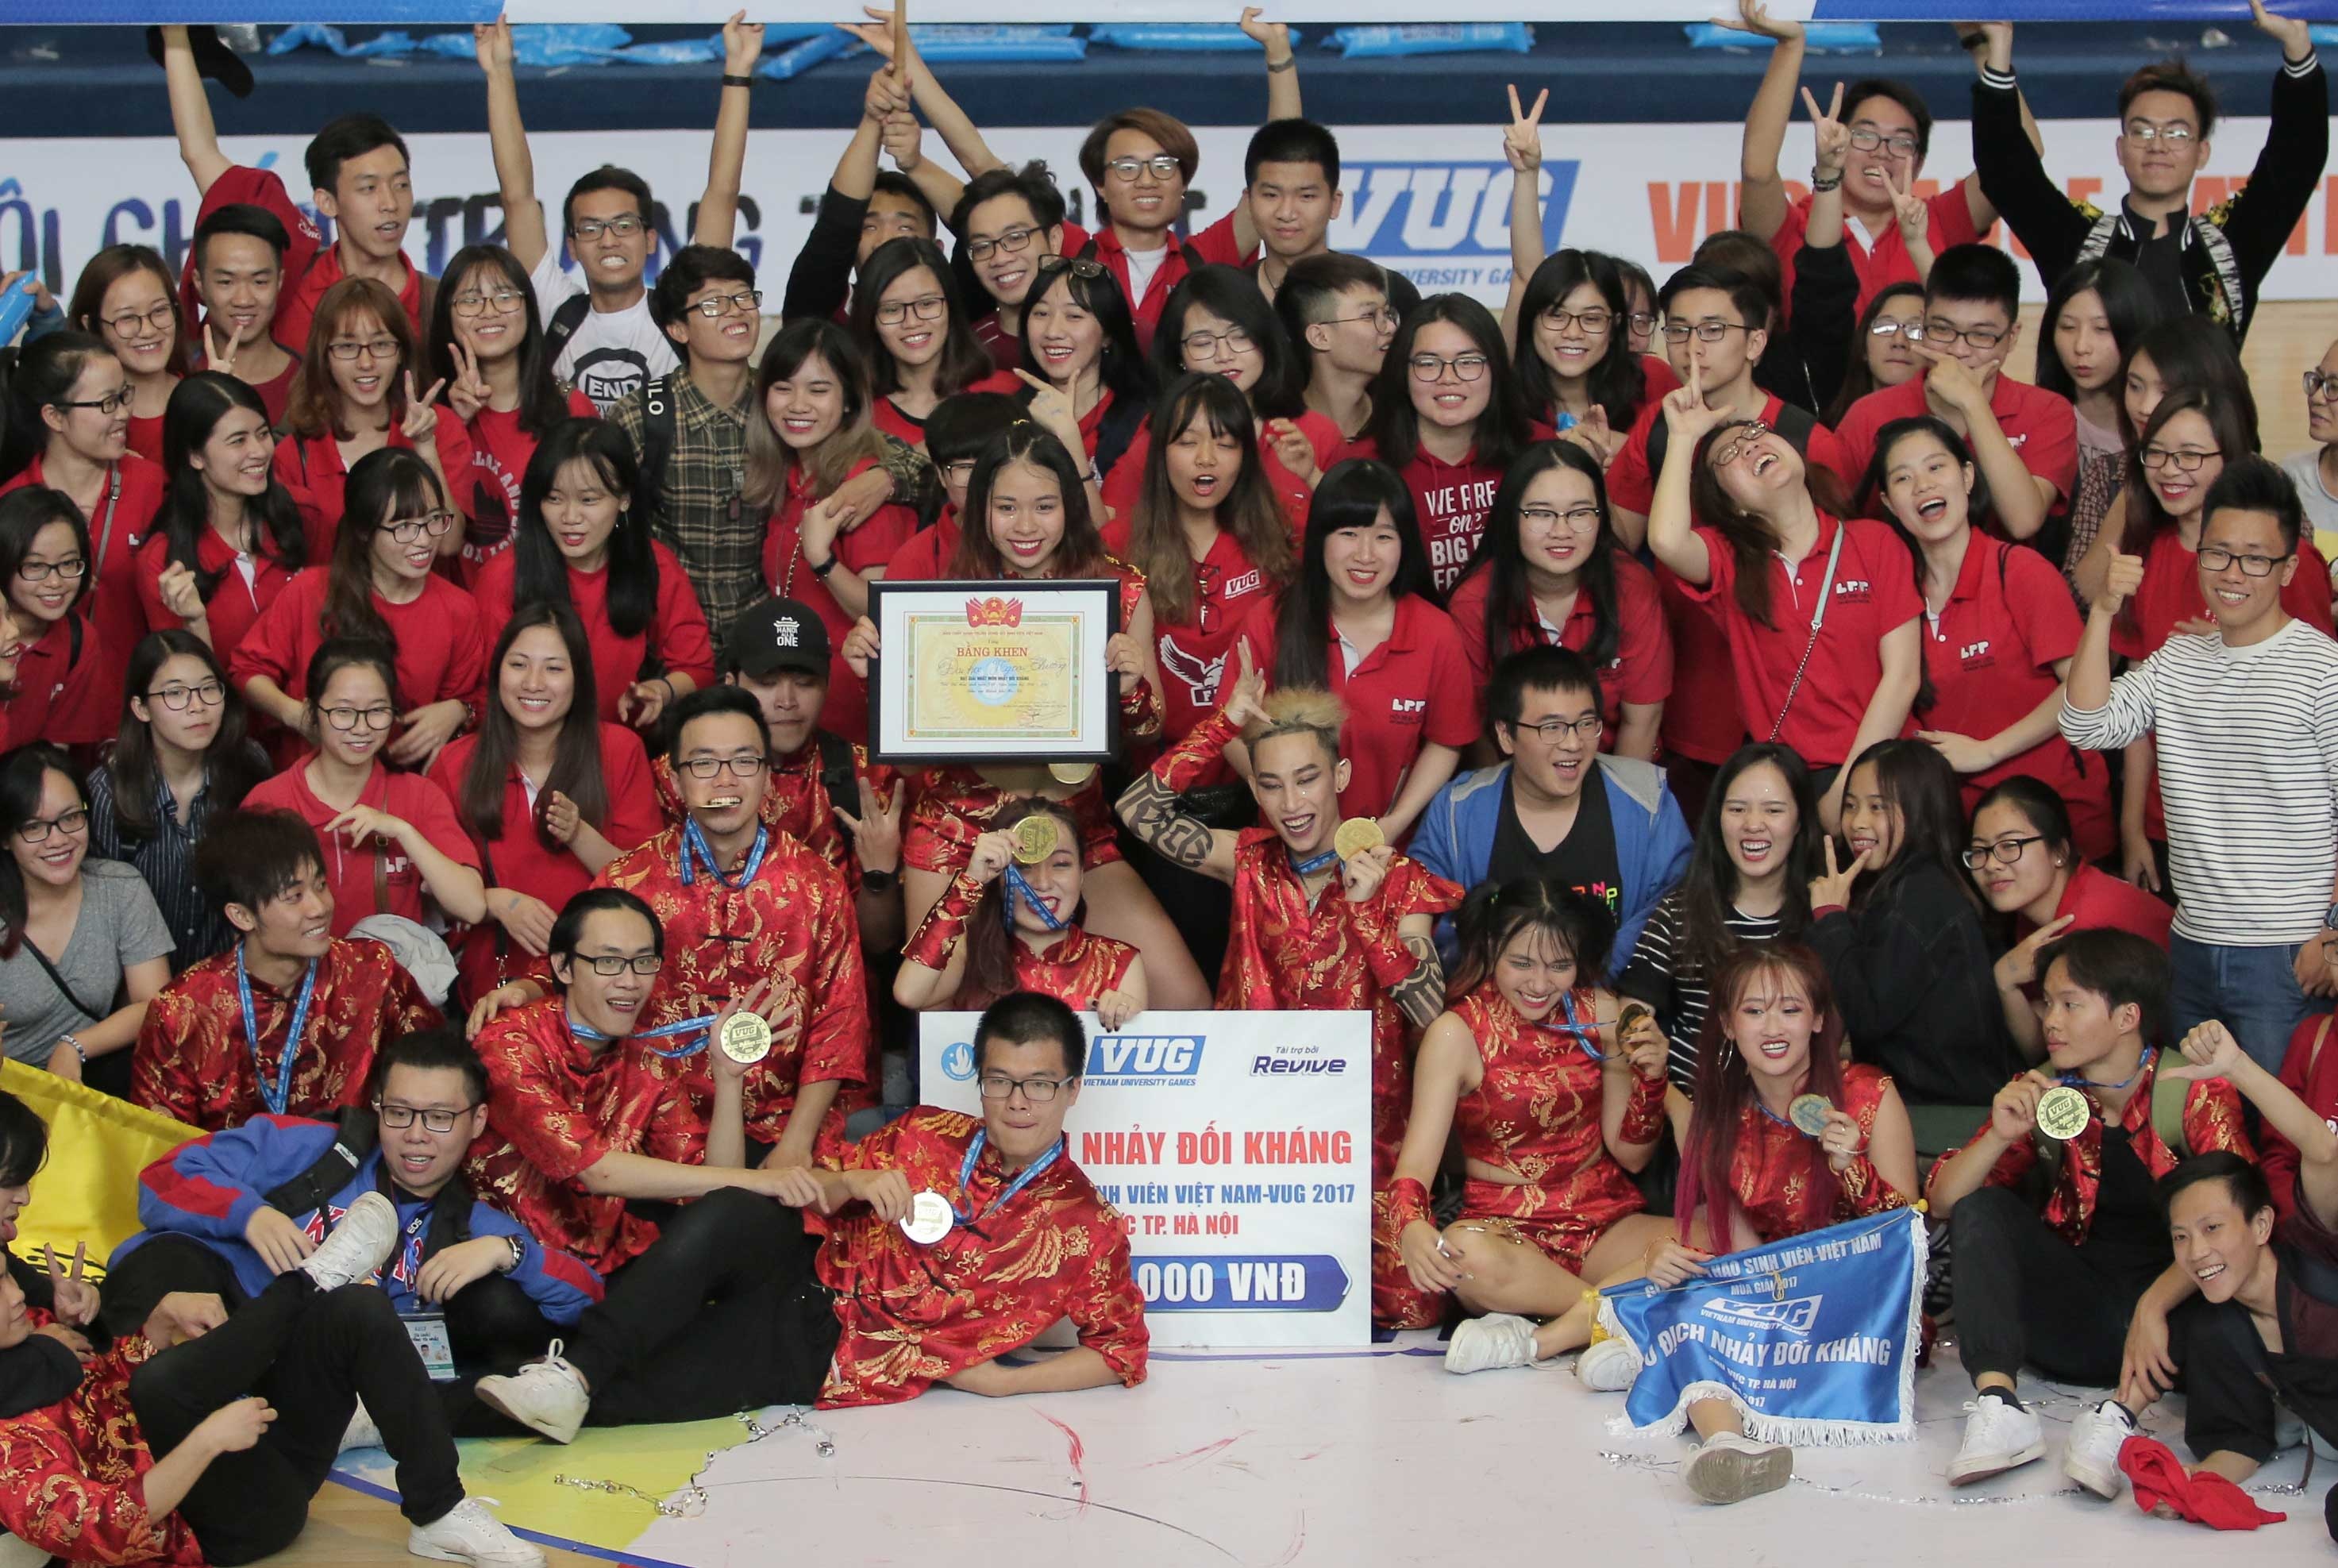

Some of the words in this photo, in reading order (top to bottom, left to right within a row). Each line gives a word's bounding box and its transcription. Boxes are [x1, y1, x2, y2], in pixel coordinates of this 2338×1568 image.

[1327, 167, 1554, 250] VUG
[1402, 268, 1481, 287] VERSITY
[648, 377, 664, 415] ILO
[1424, 486, 1457, 517] WE
[1430, 536, 1469, 566] BIG
[1230, 572, 1257, 592] VUG
[776, 636, 799, 647] ONE
[994, 647, 1028, 657] KHEN
[734, 1027, 756, 1037] VUG
[1100, 1038, 1196, 1072] VUG
[1253, 1056, 1347, 1074] Revive
[2050, 1100, 2070, 1115] VUG
[1082, 1123, 1166, 1165] NHẢY
[1177, 1120, 1231, 1165] ĐỐI
[1244, 1126, 1352, 1165] KHÁNG
[1096, 1185, 1120, 1204] NH
[1127, 1181, 1169, 1204] VIÊN
[1175, 1181, 1215, 1208] VIỆT
[1220, 1185, 1306, 1204] NAM-VUG
[1312, 1184, 1354, 1204] 2017
[406, 1217, 423, 1235] EOS
[1142, 1215, 1167, 1235] TP.
[1173, 1212, 1200, 1235] HÀ
[1206, 1212, 1238, 1240] NỘI
[1745, 1257, 1779, 1275] SINH
[1783, 1247, 1815, 1269] VIÊN
[1816, 1240, 1847, 1262] VIỆT
[1851, 1232, 1882, 1254] NAM
[1227, 1262, 1307, 1302] VNĐ
[1701, 1308, 1736, 1325] VIETNAM
[1657, 1322, 1705, 1358] ĐỊCH
[1710, 1330, 1770, 1367] NHẢY
[1815, 1331, 1891, 1366] KHÁNG
